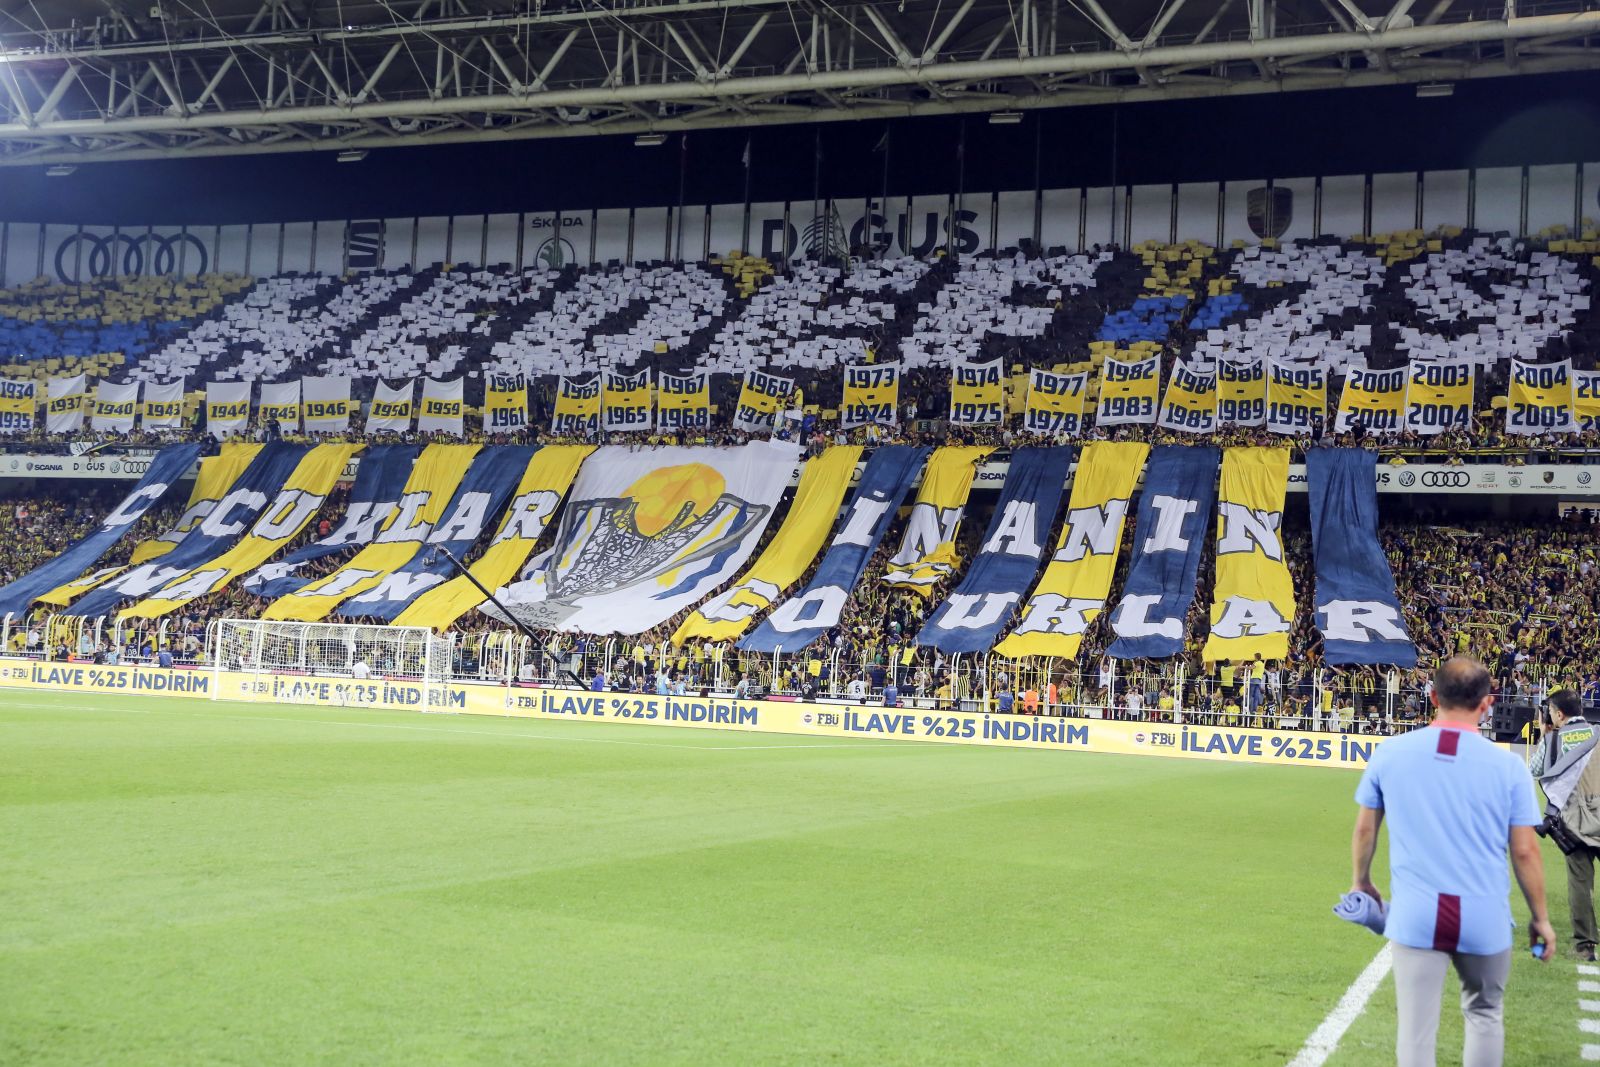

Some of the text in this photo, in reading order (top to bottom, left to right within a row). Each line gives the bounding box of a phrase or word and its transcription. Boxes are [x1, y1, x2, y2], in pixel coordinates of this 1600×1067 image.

[607, 369, 647, 392] 1964
[848, 367, 894, 389] 1973
[956, 366, 999, 387] 1974
[1106, 359, 1155, 382] 1982
[1174, 368, 1217, 394] 1984
[1272, 365, 1323, 390] 1995
[1350, 370, 1403, 392] 2000
[1413, 364, 1469, 388] 2003
[1515, 363, 1567, 389] 2004
[0, 382, 34, 399] 1934
[490, 375, 525, 393] 1960
[562, 376, 600, 400] 1963
[663, 373, 705, 394] 1967
[747, 371, 790, 398] 1969
[1034, 372, 1083, 397] 1977
[51, 395, 82, 412] 1937
[96, 402, 133, 415] 1940
[147, 402, 180, 417] 1943
[211, 403, 247, 418] 1944
[307, 401, 347, 417] 1946
[372, 403, 409, 416] 1950
[426, 401, 460, 415] 1959
[846, 402, 893, 422] 1974
[952, 402, 1002, 422] 1975
[1102, 396, 1153, 417] 1983
[1218, 398, 1264, 420] 1989
[1409, 403, 1469, 426] 2004
[491, 408, 525, 426] 1961
[555, 413, 598, 432] 1964
[607, 406, 647, 425] 1965
[660, 408, 708, 427] 1968
[1027, 408, 1078, 431] 1978
[1166, 402, 1213, 429] 1985
[1345, 406, 1397, 429] 2001
[1512, 403, 1569, 427] 2005
[32, 663, 84, 686] İLAVE
[89, 670, 128, 688] %25
[132, 668, 208, 693] İNDİRİM
[383, 682, 466, 708] İNDRİM
[541, 690, 605, 716] İLAVE
[611, 699, 658, 720] %25
[665, 697, 757, 725] İNDİRİM
[817, 707, 1088, 745] FBÜ İLAVE %25 İNDİRİM
[1561, 730, 1593, 744] iddaa
[1151, 732, 1176, 746] FBÜ
[1181, 726, 1262, 756] İLAVE
[1271, 737, 1332, 760] %25
